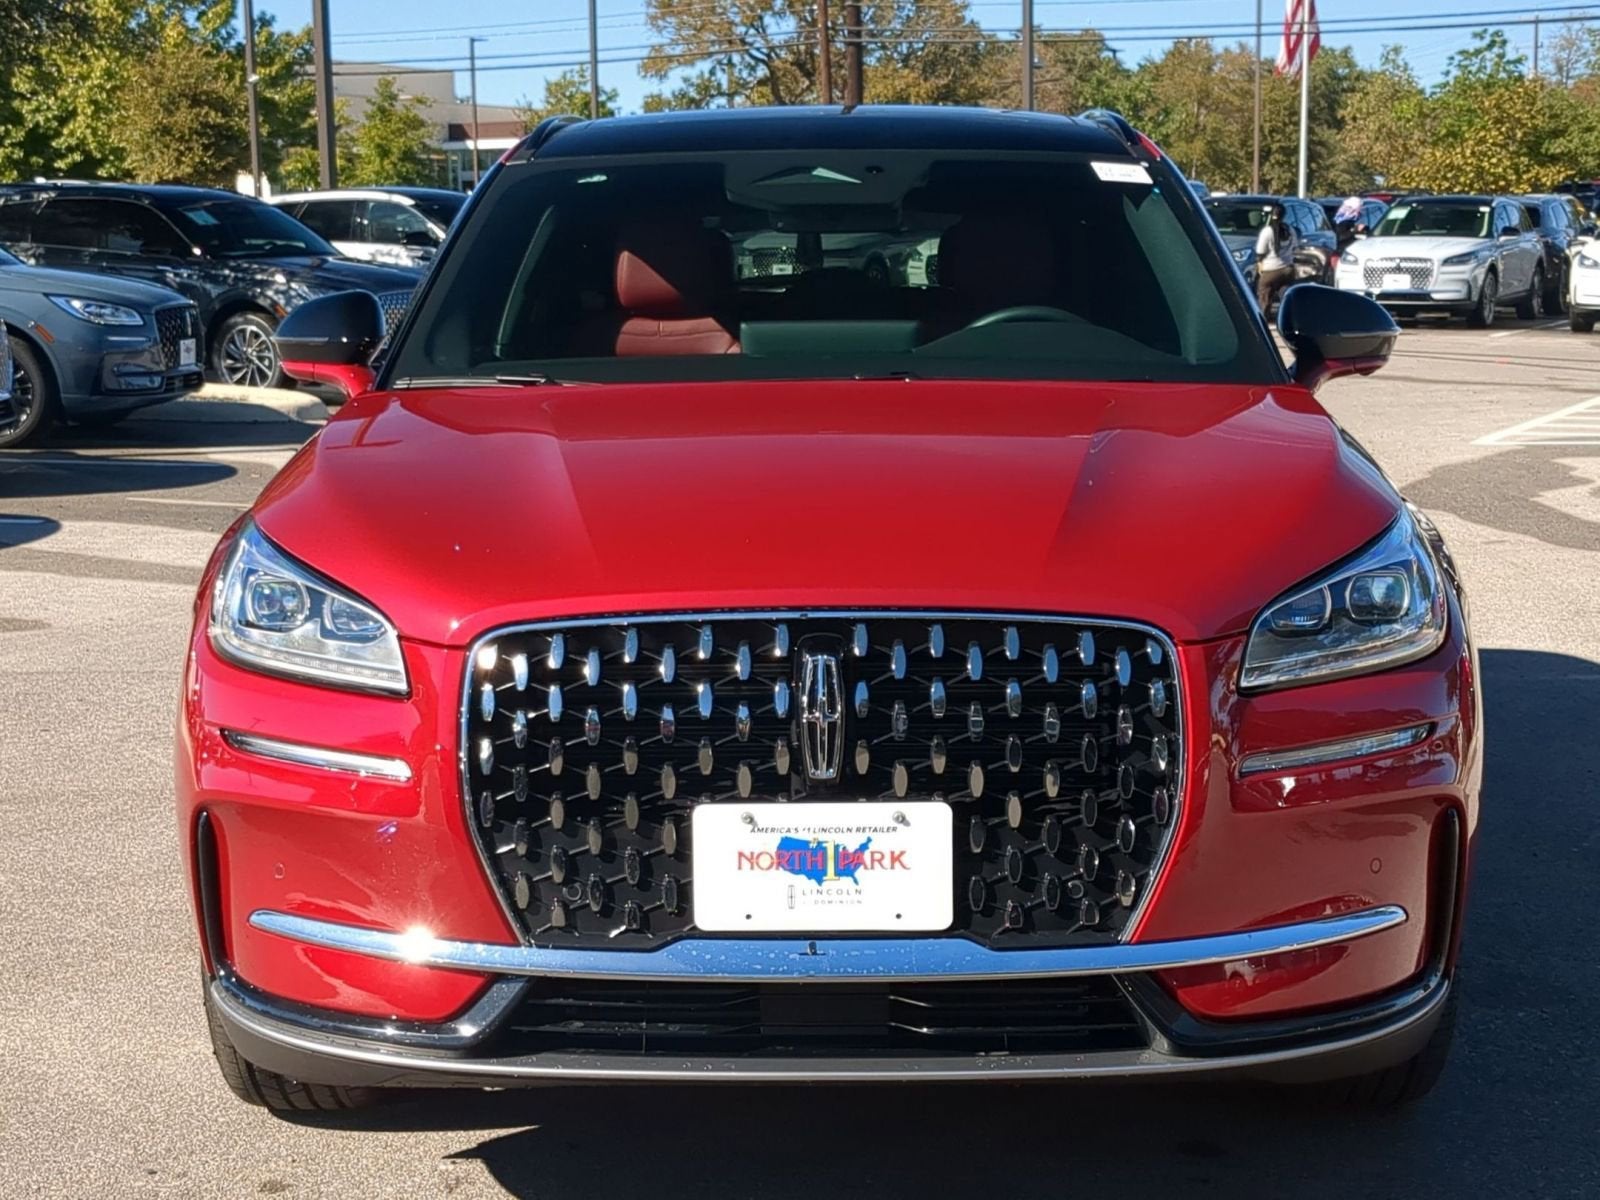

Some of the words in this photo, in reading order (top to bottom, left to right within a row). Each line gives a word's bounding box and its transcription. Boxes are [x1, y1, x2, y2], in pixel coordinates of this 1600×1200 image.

[750, 826, 799, 834] AMERICA'S
[813, 826, 854, 834] LINCOLN
[737, 850, 825, 871] NORTH
[839, 850, 911, 871] PARK
[802, 888, 863, 896] LINCOLN
